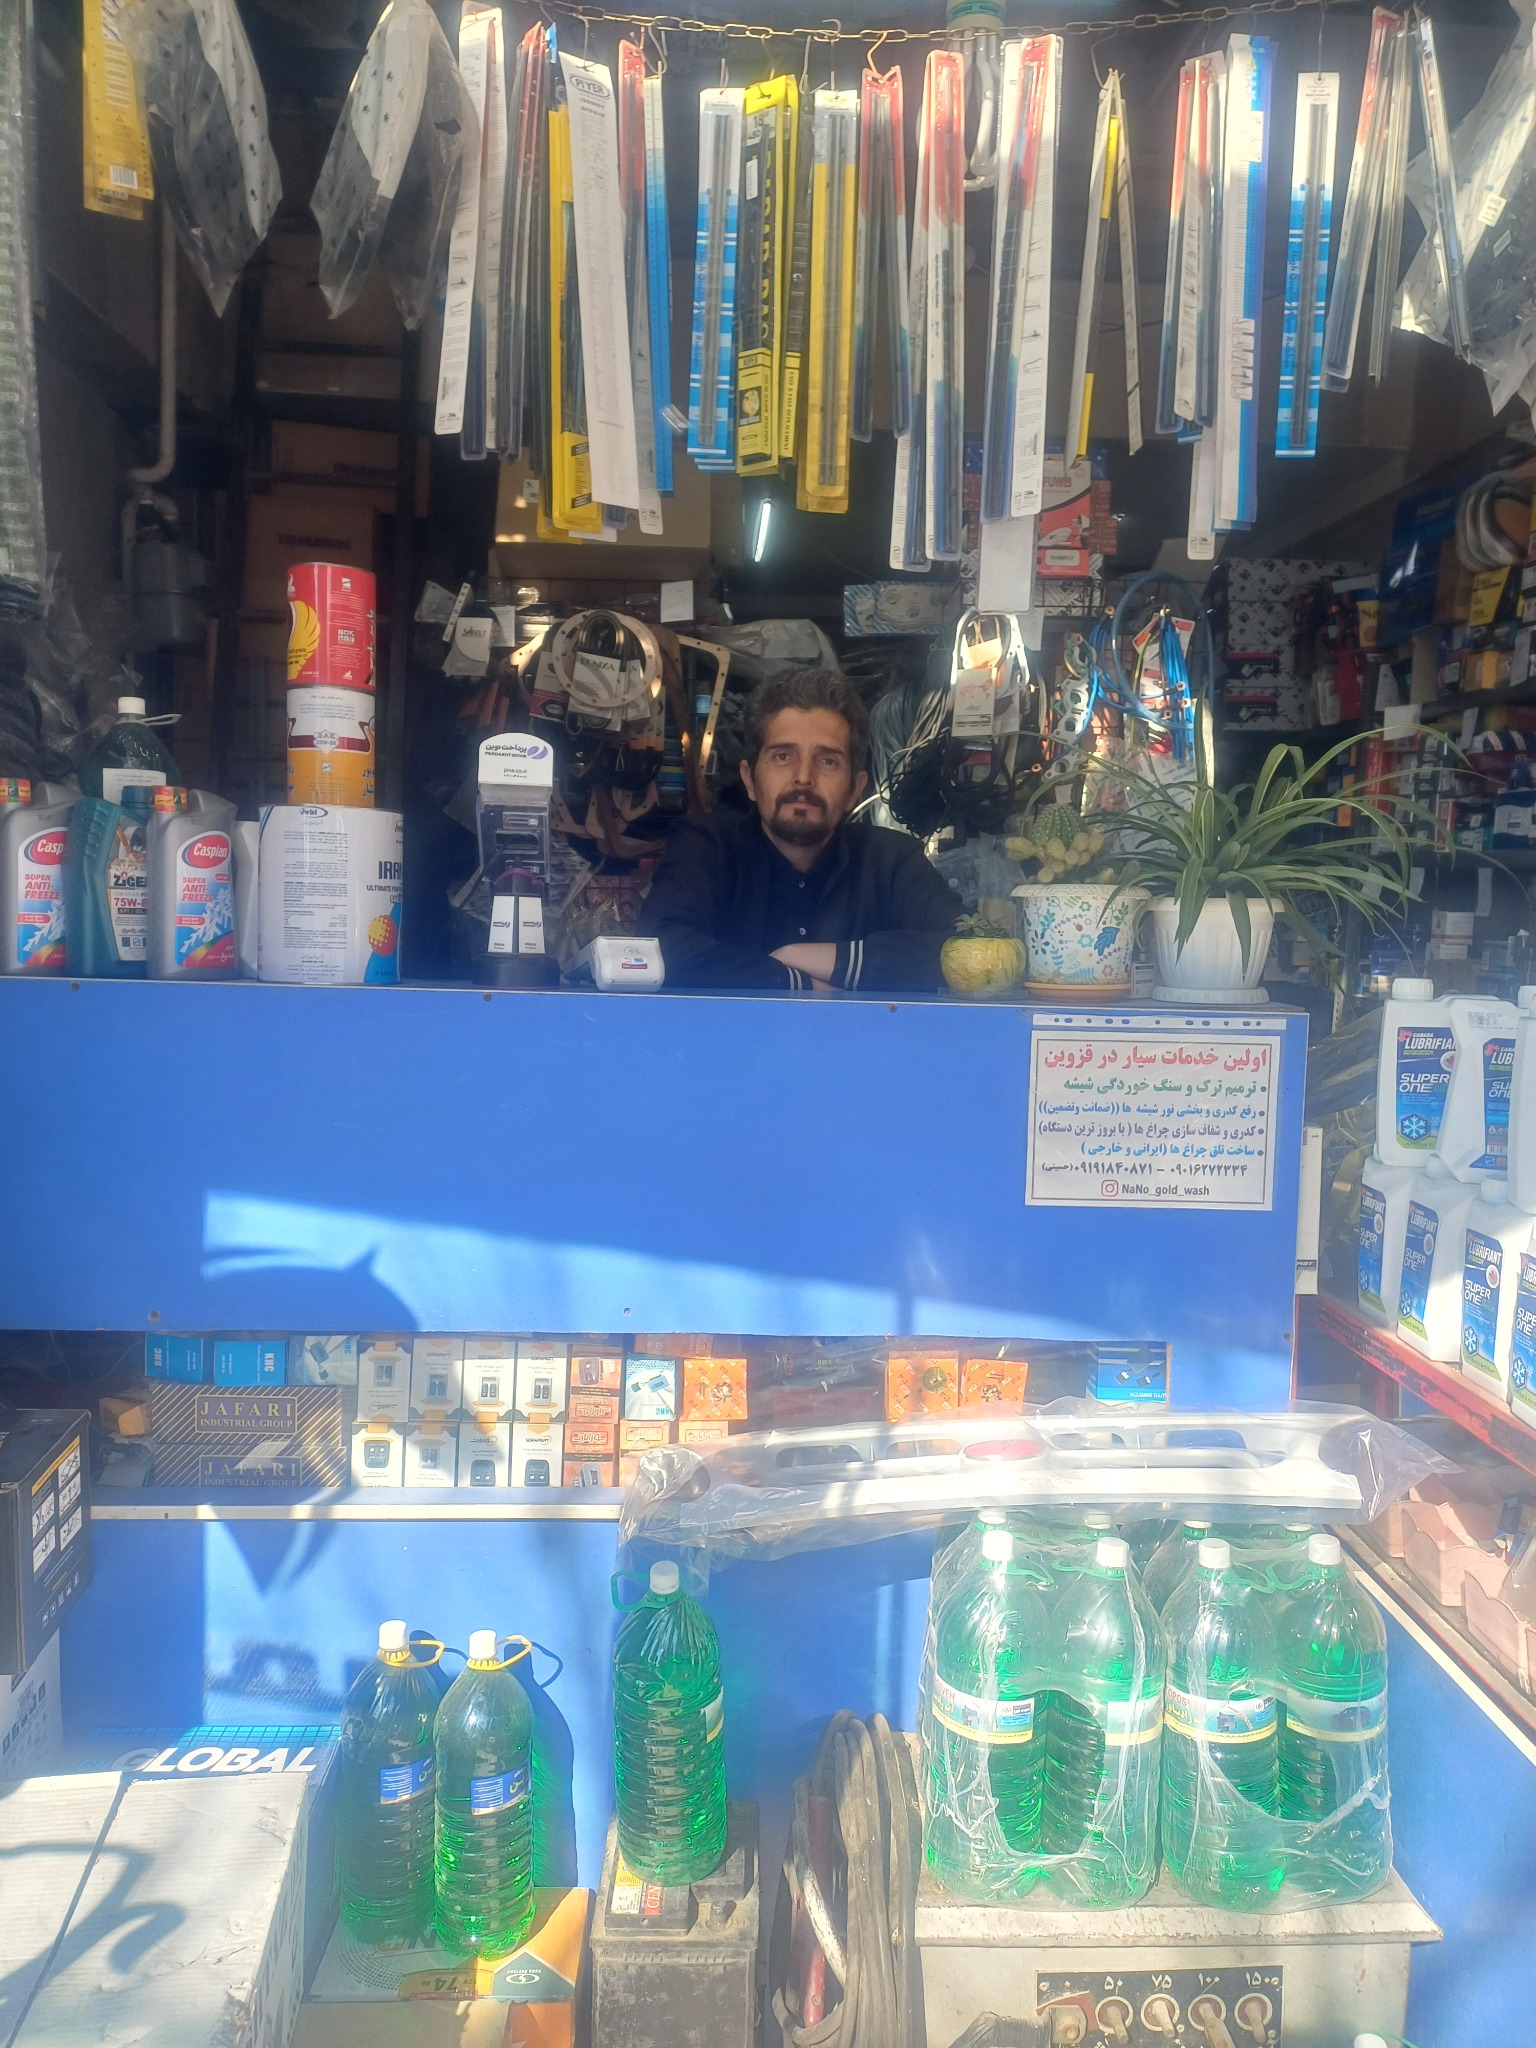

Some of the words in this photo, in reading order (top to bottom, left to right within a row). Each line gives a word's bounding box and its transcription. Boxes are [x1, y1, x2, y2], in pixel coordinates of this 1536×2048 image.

[316, 738, 337, 746] 20W-50
[317, 732, 337, 740] SAE
[193, 842, 228, 859] Caspian
[24, 873, 52, 881] SUPER
[182, 876, 206, 884] SUPER
[24, 881, 54, 891] ANTI-
[181, 884, 208, 893] ANTI-
[366, 884, 392, 892] ULTIMATE
[24, 890, 60, 901] FREEZE
[181, 893, 214, 903] FREEZE
[1044, 1043, 1094, 1069] قزوین
[1096, 1049, 1118, 1069] در
[1121, 1046, 1157, 1070] سیار
[1161, 1046, 1219, 1066] خدمات
[1223, 1047, 1267, 1073] اولین
[1063, 1076, 1094, 1094] شیشه
[1096, 1076, 1150, 1096] خوردگی
[1153, 1078, 1182, 1092] سنگ
[1400, 1073, 1450, 1084] SUPER
[1184, 1084, 1193, 1097] و
[1196, 1079, 1223, 1098] ترک
[1226, 1080, 1258, 1098] ترمیم
[1399, 1083, 1434, 1093] ONE
[1122, 1102, 1132, 1113] ها
[1135, 1103, 1159, 1117] شیشه
[1160, 1103, 1175, 1118] نور
[1204, 1108, 1211, 1119] و
[1212, 1105, 1239, 1119] کدری
[1239, 1104, 1257, 1119] رفع
[1074, 1121, 1096, 1137] ترین
[1096, 1122, 1116, 1138] بروز
[1134, 1122, 1144, 1135] ها
[1145, 1122, 1170, 1139] چراغ
[1171, 1123, 1196, 1139] سازی
[1198, 1123, 1221, 1137] شفاف
[1222, 1129, 1229, 1140] و
[1230, 1125, 1257, 1140] کدری
[1124, 1146, 1131, 1157] و
[1169, 1143, 1180, 1154] ها
[1181, 1142, 1208, 1159] چراغ
[1209, 1144, 1225, 1158] تلق
[1226, 1144, 1255, 1157] ساخت
[1121, 1184, 1210, 1197] NaNo_gold_wash
[1410, 1212, 1438, 1234] LUBRIFIANT
[1360, 1227, 1377, 1243] SUPER
[1360, 1236, 1371, 1250] ONE
[1405, 1247, 1427, 1265] SUPER
[1469, 1240, 1502, 1265] LUBRIFIANT
[1403, 1257, 1419, 1272] ONE
[1465, 1279, 1491, 1299] SUPER
[1464, 1289, 1482, 1306] ONE
[1516, 1318, 1534, 1336] ONE
[264, 1352, 275, 1372] KHC
[200, 1402, 293, 1417] JAFARI
[200, 1418, 257, 1428] INDUSTRIAL
[259, 1419, 293, 1429] GROUP
[204, 1461, 297, 1477] JAFARI
[204, 1478, 262, 1488] INDUSTRIAL
[263, 1479, 297, 1488] GROUP
[110, 1746, 317, 1773] GLOBAL
[433, 1976, 458, 1992] 74
[1151, 1974, 1172, 1989] ۷۵
[1198, 1972, 1221, 1986] ۱۰۰
